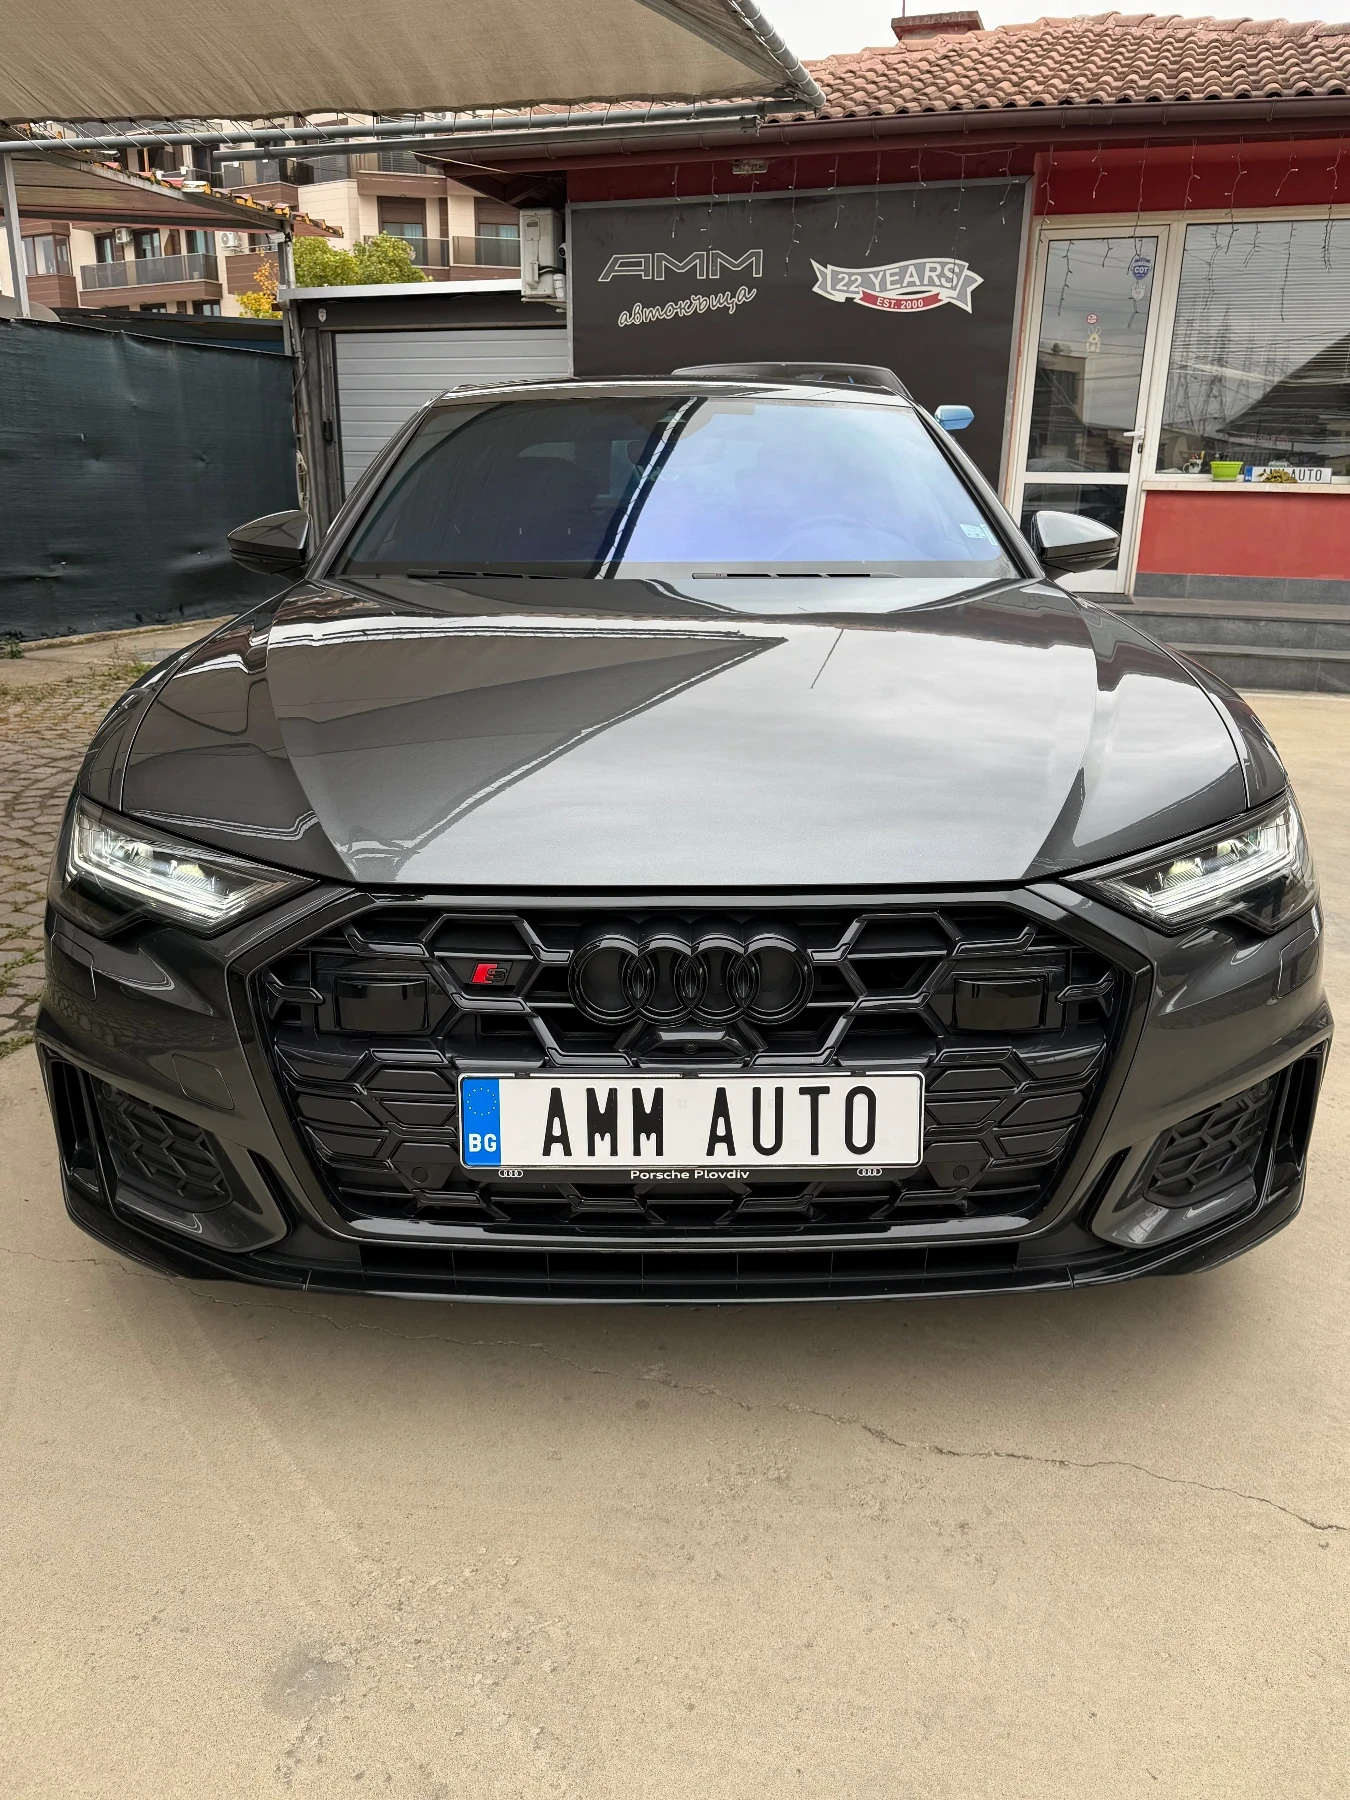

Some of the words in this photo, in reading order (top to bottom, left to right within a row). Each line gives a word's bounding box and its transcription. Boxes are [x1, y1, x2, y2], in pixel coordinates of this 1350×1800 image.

[598, 249, 763, 281] AMM
[836, 273, 862, 292] 22
[868, 262, 962, 292] YEARS
[618, 286, 757, 328] автокъща
[876, 297, 897, 309] EST.
[900, 299, 924, 309] 2000
[1290, 469, 1323, 482] AUTO
[542, 1087, 664, 1157] AMM
[706, 1085, 877, 1157] AUTO
[468, 1133, 497, 1153] BG
[630, 1170, 690, 1180] Porsche
[694, 1169, 750, 1179] Plovdiv
